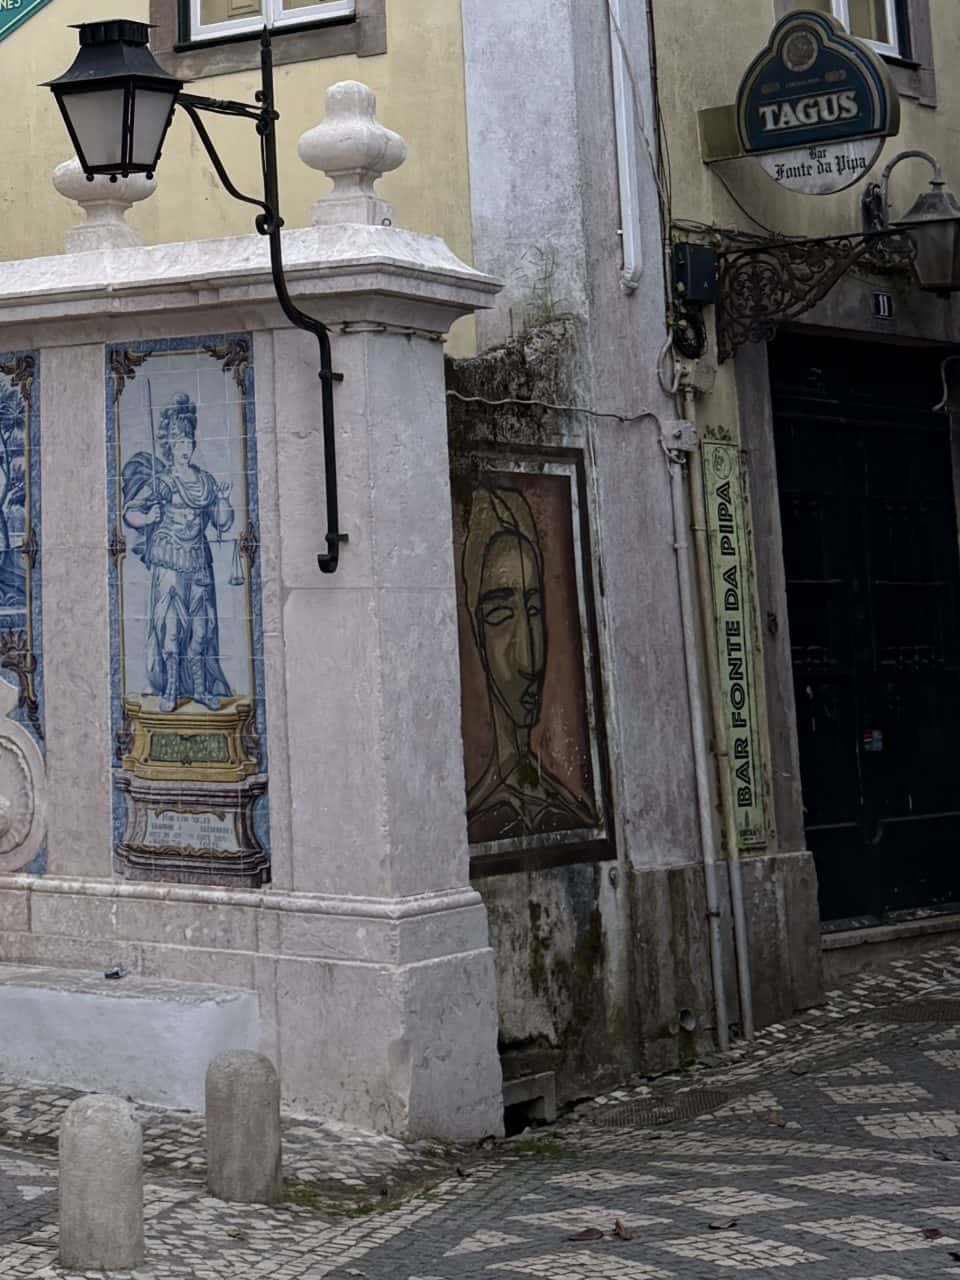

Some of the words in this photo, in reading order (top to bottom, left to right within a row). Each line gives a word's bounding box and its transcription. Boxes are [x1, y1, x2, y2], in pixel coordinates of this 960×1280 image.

[758, 90, 859, 131] TAGUS
[774, 163, 813, 180] Fonte
[816, 159, 832, 174] da
[835, 155, 867, 176] Pipa
[808, 145, 827, 160] Bar
[716, 481, 737, 556] PIPA
[722, 565, 740, 611] DA
[725, 621, 748, 728] FONTE
[735, 737, 753, 808] BAR
